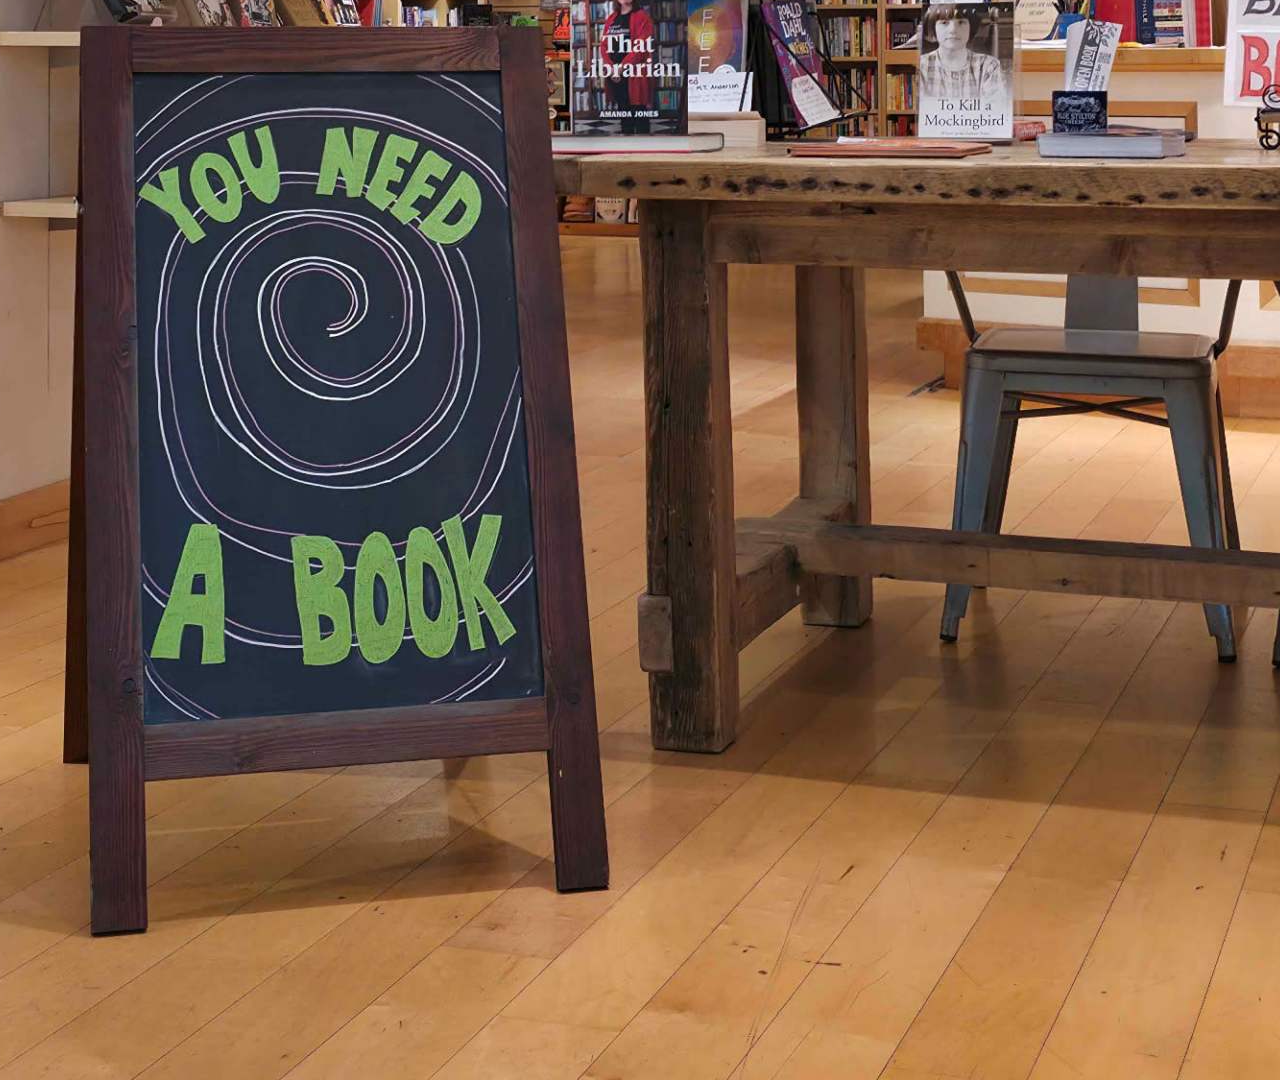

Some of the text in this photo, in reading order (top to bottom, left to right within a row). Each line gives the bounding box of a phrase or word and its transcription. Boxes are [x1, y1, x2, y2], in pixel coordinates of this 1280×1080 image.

[778, 3, 802, 22] ROALD
[780, 20, 806, 38] DAHL
[602, 34, 655, 54] That
[576, 60, 681, 78] Librarian
[1075, 46, 1098, 89] OPEN BOOK
[938, 98, 992, 111] To Kill a
[924, 113, 1005, 129] Mockingbird
[139, 125, 482, 245] YOU NEED
[150, 514, 517, 665] A BOOK
